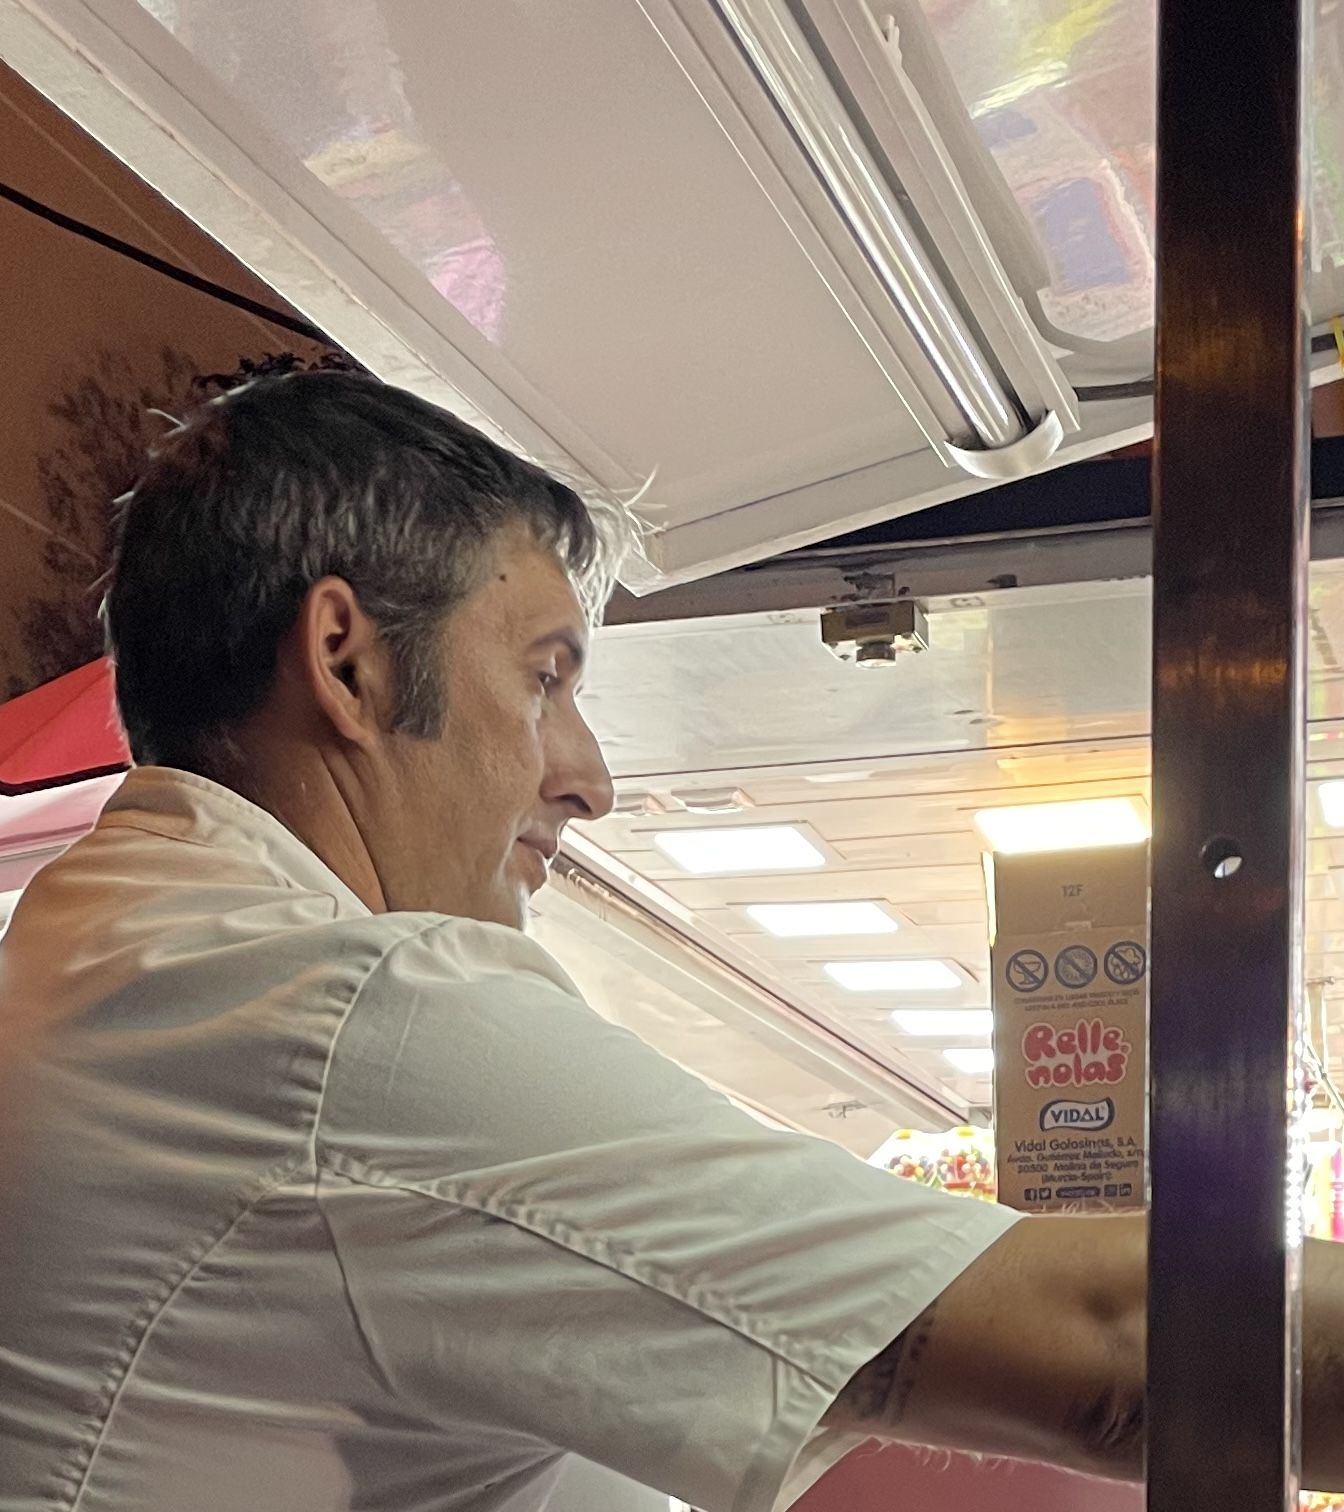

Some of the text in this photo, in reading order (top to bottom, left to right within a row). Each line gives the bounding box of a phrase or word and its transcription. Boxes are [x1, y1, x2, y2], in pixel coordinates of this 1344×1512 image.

[1022, 1018, 1122, 1064] Relle
[1025, 1052, 1128, 1088] nolas
[1050, 1107, 1105, 1124] VIDAL
[1015, 1140, 1046, 1153] Vidal
